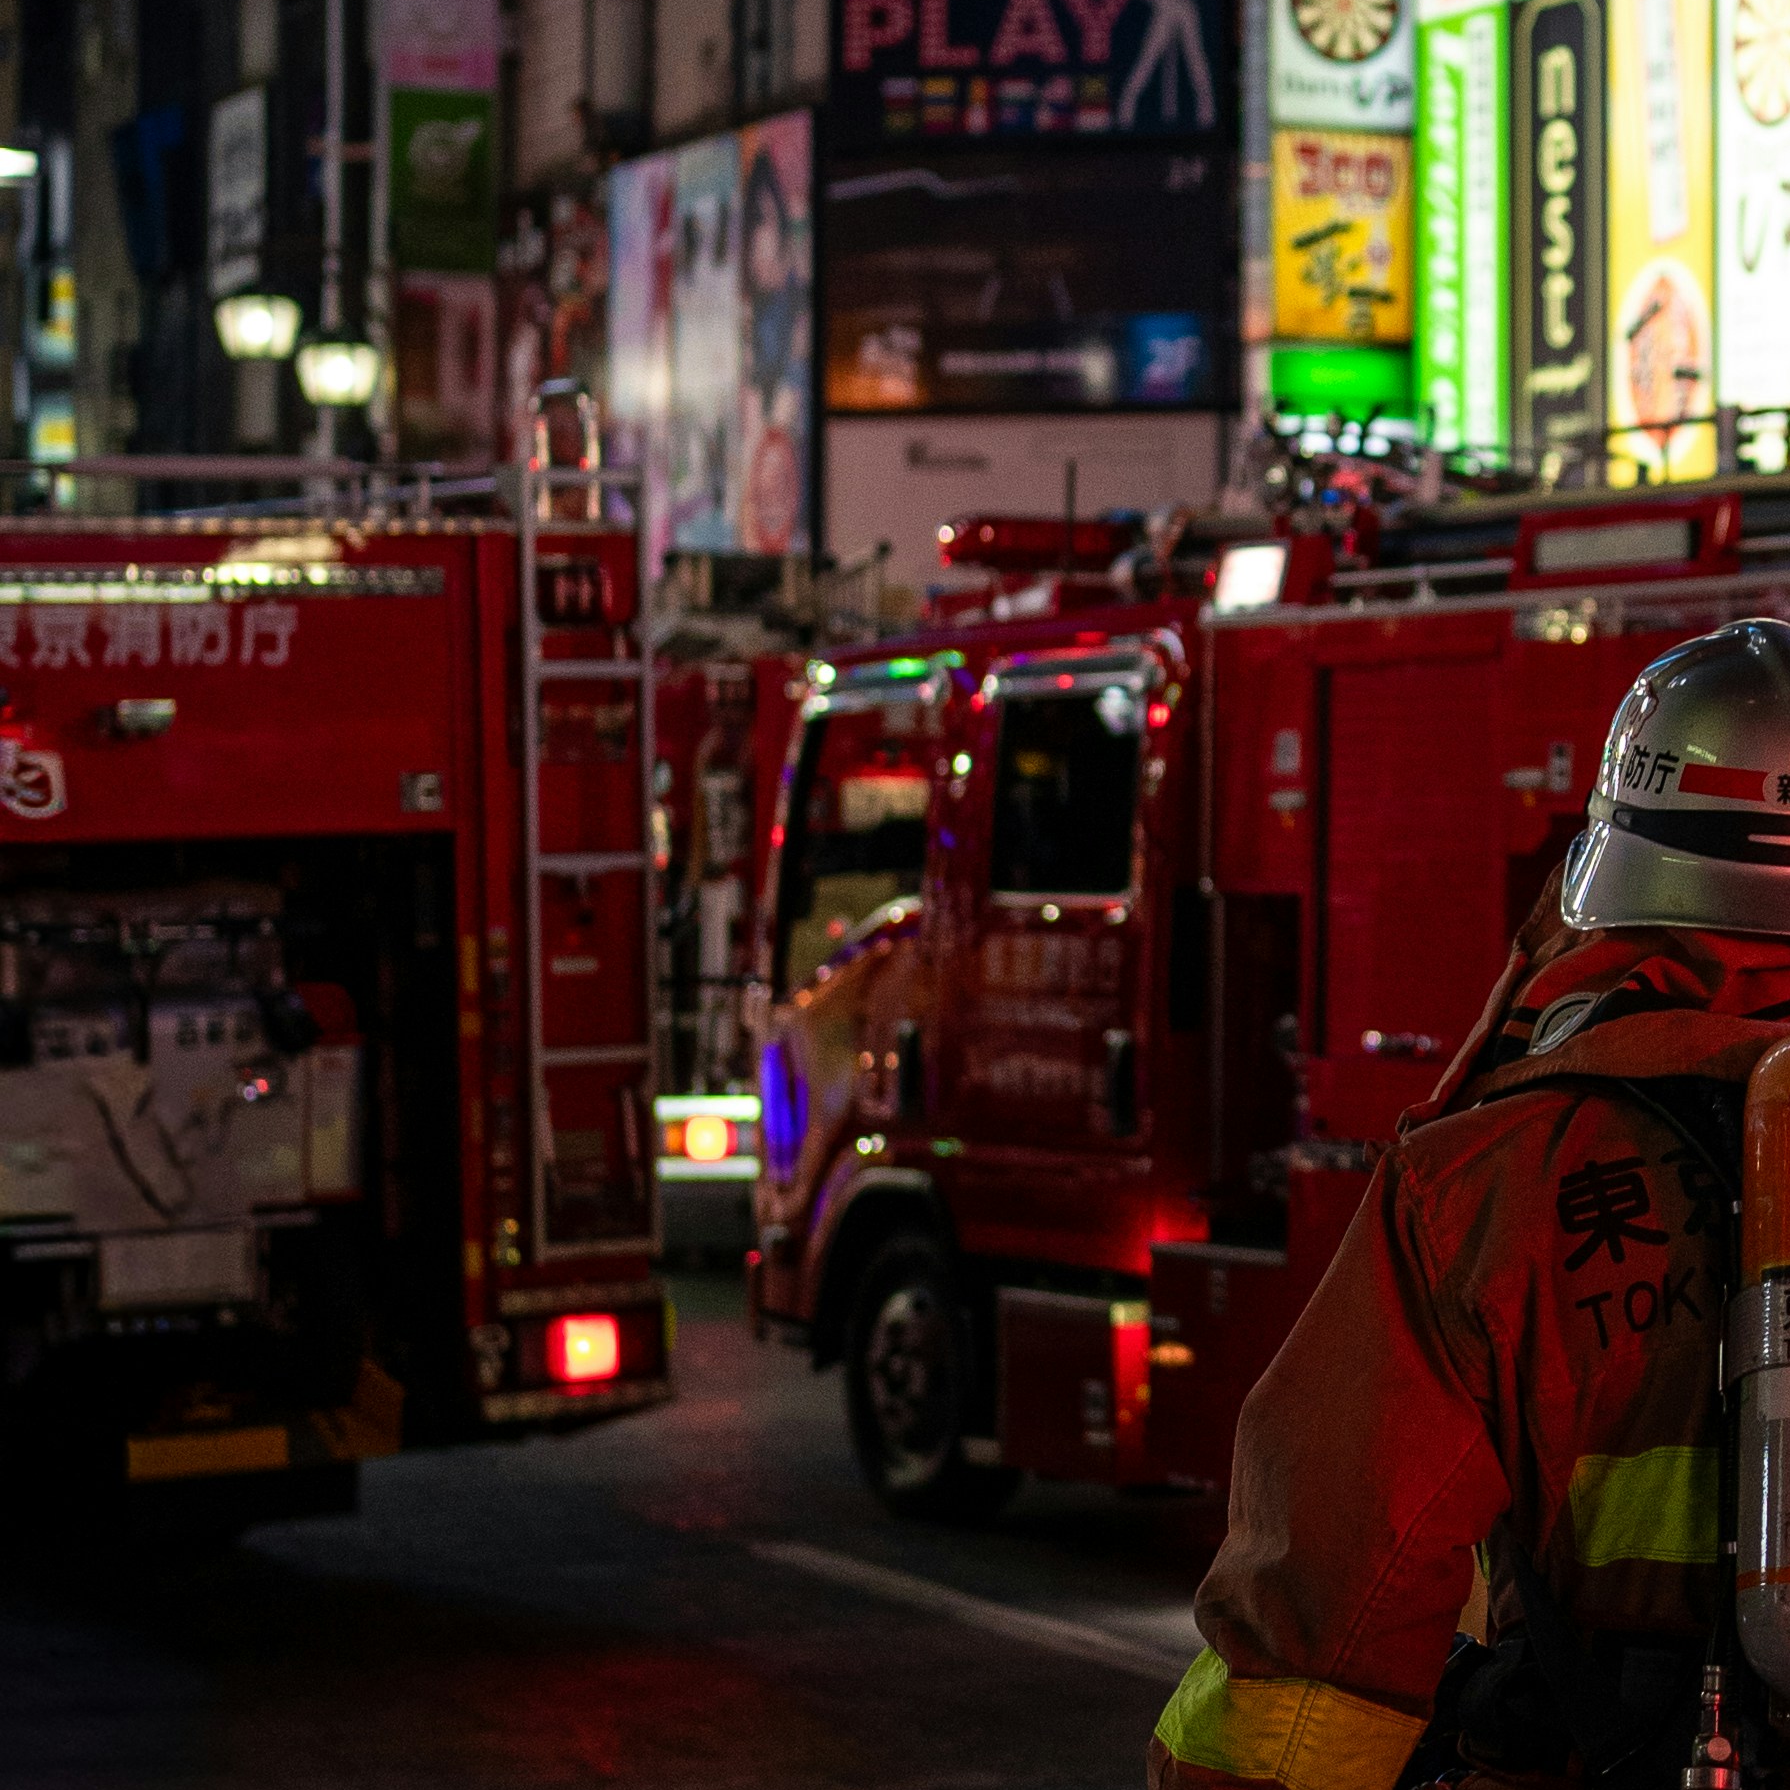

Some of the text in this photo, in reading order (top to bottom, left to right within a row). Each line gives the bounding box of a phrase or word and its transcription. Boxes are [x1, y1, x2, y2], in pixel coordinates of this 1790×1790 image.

[1535, 44, 1578, 349] nest
[1619, 744, 1681, 795] 防庁
[1575, 1266, 1703, 1350] TOK
